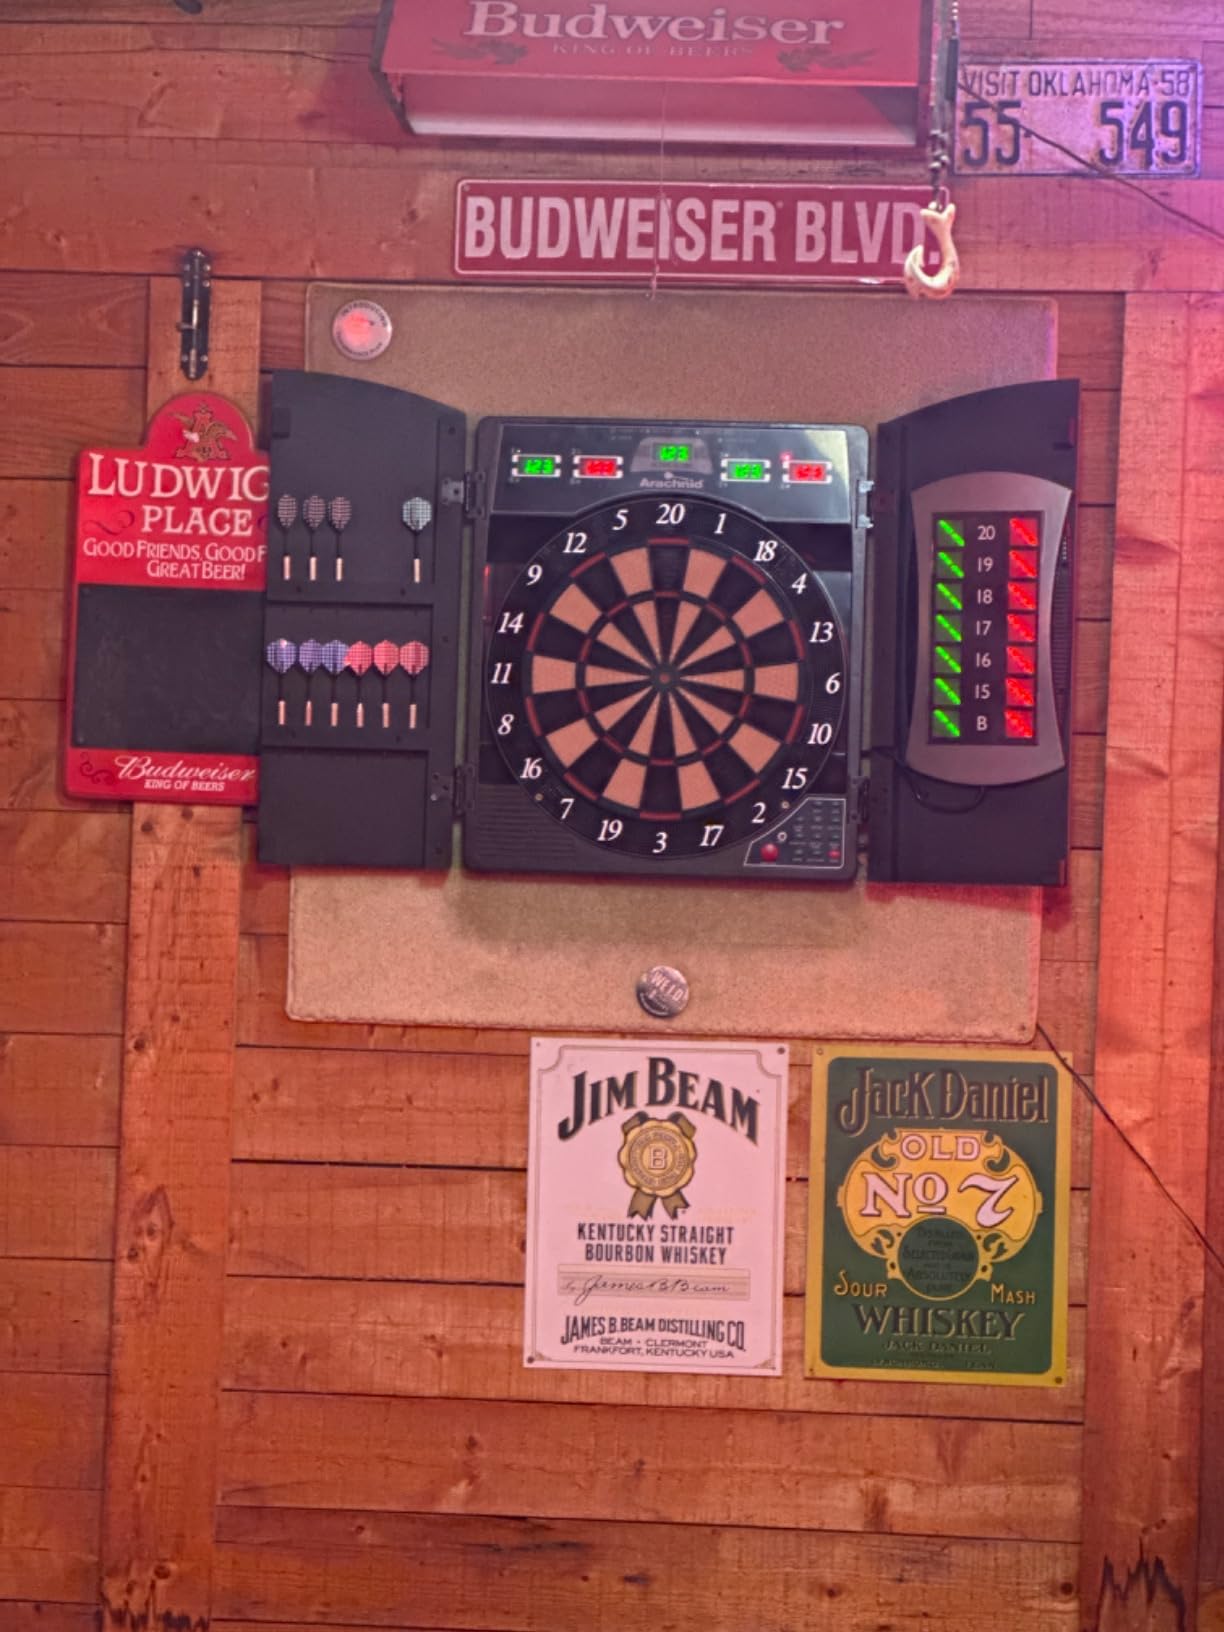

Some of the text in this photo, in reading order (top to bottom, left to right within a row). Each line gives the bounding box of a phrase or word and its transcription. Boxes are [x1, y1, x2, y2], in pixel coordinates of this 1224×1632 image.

[463, 0, 845, 46] Budweiser
[552, 43, 614, 55] KING
[626, 46, 656, 56] OF
[962, 70, 1190, 97] VISIT OKLAHOMA 58
[962, 100, 1189, 170] 55 549
[463, 197, 777, 263] BUDWEISER
[639, 478, 705, 490] Arachnid
[140, 504, 253, 538] PLACE
[612, 508, 630, 531] 5
[655, 503, 686, 525] 20
[713, 512, 727, 535] 1
[563, 531, 588, 554] 12
[977, 525, 996, 541] 20
[83, 537, 135, 559] GOOD
[204, 542, 256, 564] GOOD
[753, 539, 777, 563] 18
[146, 560, 246, 581] GREAT BEER!
[526, 564, 543, 587] 9
[977, 556, 994, 573] 19
[791, 571, 807, 595] 4
[977, 588, 993, 605] 18
[498, 611, 525, 635] 14
[808, 620, 834, 644] 13
[976, 619, 992, 636] 17
[976, 652, 992, 668] 16
[491, 662, 512, 685] 11
[825, 671, 841, 695] 6
[975, 684, 991, 700] 15
[497, 713, 514, 737] 8
[807, 721, 833, 745] 10
[976, 715, 988, 732] B
[115, 756, 256, 782] Budweiser
[519, 756, 544, 780] 16
[781, 766, 808, 790] 15
[144, 778, 226, 793] KING OF BEERS
[560, 797, 575, 820] 7
[751, 801, 766, 824] 2
[596, 818, 623, 842] 19
[699, 824, 724, 847] 17
[651, 831, 669, 854] 3
[557, 1056, 760, 1147] JIM BEAM
[901, 1134, 982, 1161] OLD
[957, 1172, 1020, 1229] 7
[577, 1222, 735, 1245] KENTUCKY STRAIGHT
[585, 1243, 728, 1266] BOURBON WHISKEY
[833, 1269, 1036, 1305] SOUR MASH
[560, 1316, 605, 1346] JAMES
[621, 1317, 656, 1333] BEAM
[658, 1318, 725, 1348] DISTILLING
[853, 1303, 1025, 1341] WHISKEY
[600, 1337, 709, 1350] BEAM CLERMONT
[649, 1348, 708, 1359] KENTUCKY
[709, 1350, 735, 1360] USA
